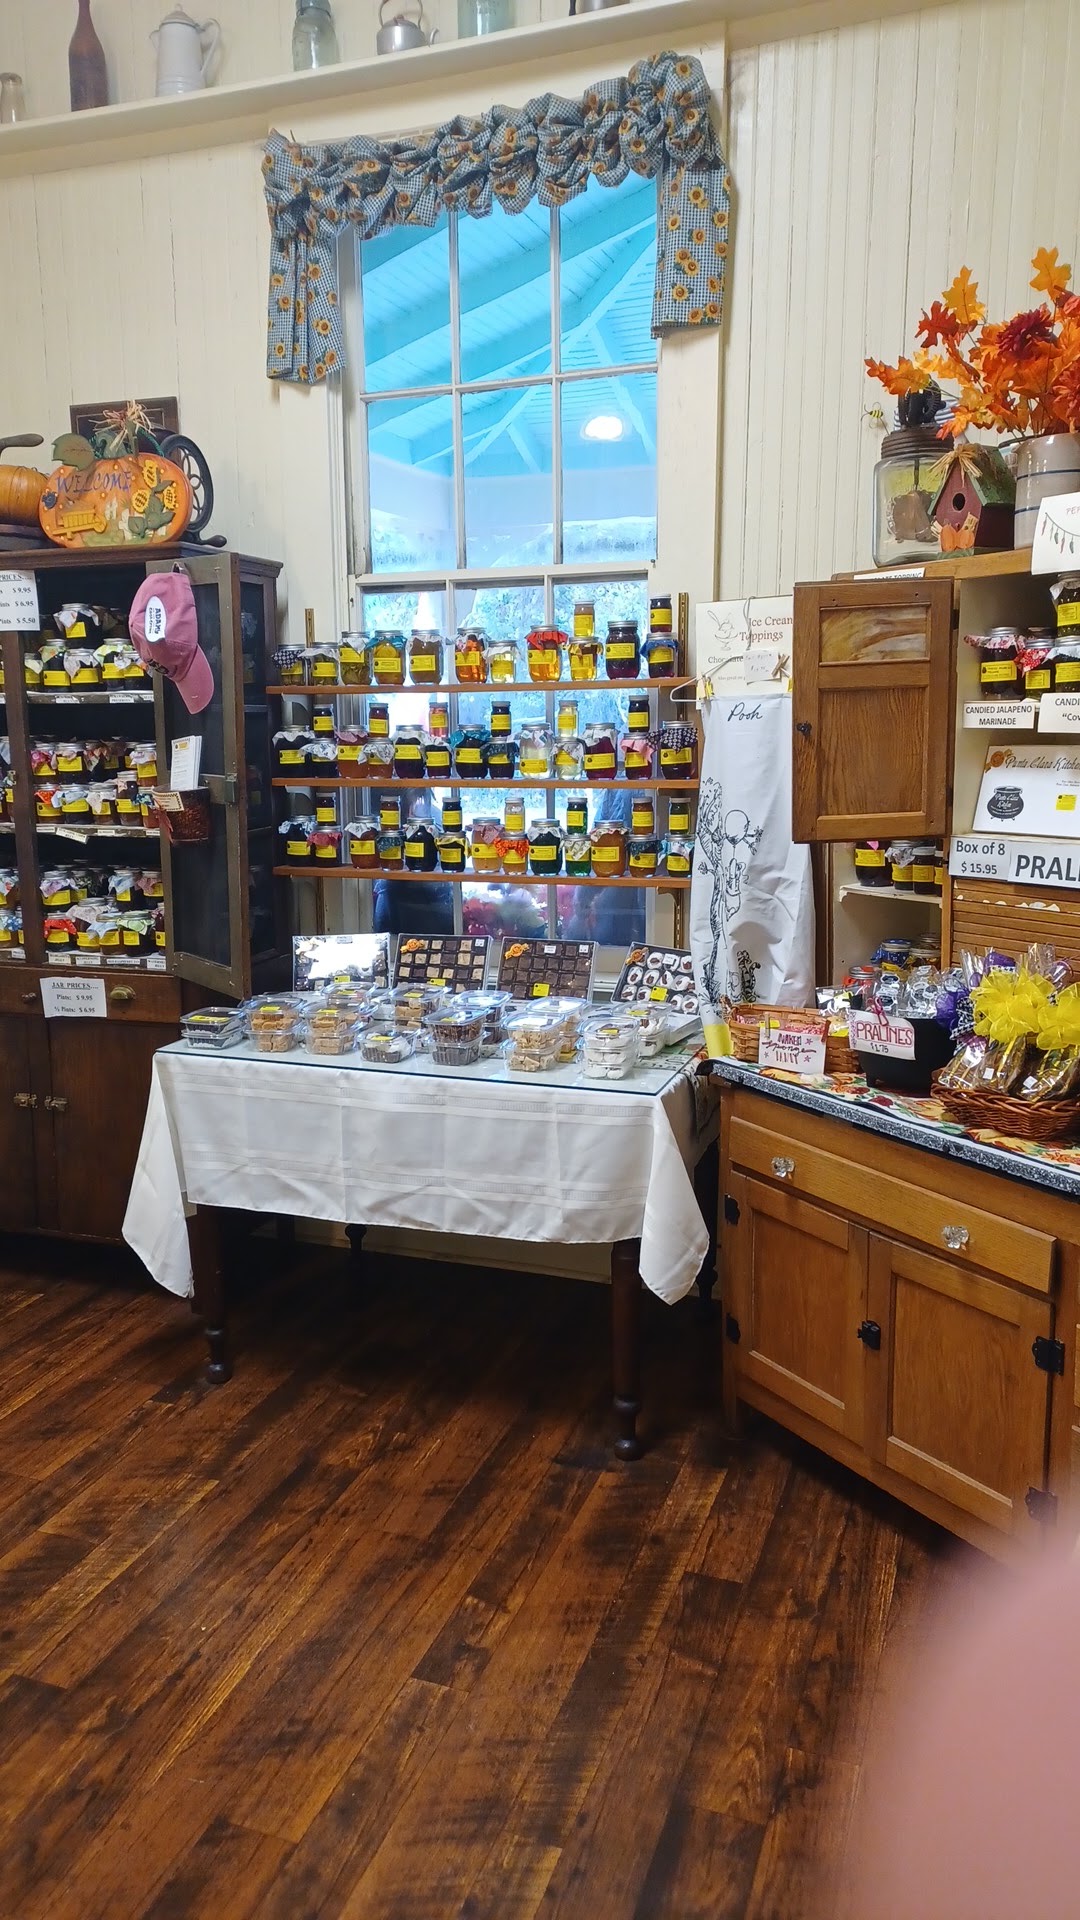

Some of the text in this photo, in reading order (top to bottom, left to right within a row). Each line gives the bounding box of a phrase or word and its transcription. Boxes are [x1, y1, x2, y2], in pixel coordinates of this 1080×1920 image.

[56, 471, 131, 492] WELCOME
[739, 631, 784, 643] Toppings
[727, 702, 763, 722] Pooh
[997, 705, 1032, 714] JALAPENO
[956, 840, 1005, 855] Box of 8
[961, 861, 997, 874] $ 15.95
[856, 1022, 913, 1045] PRALINES
